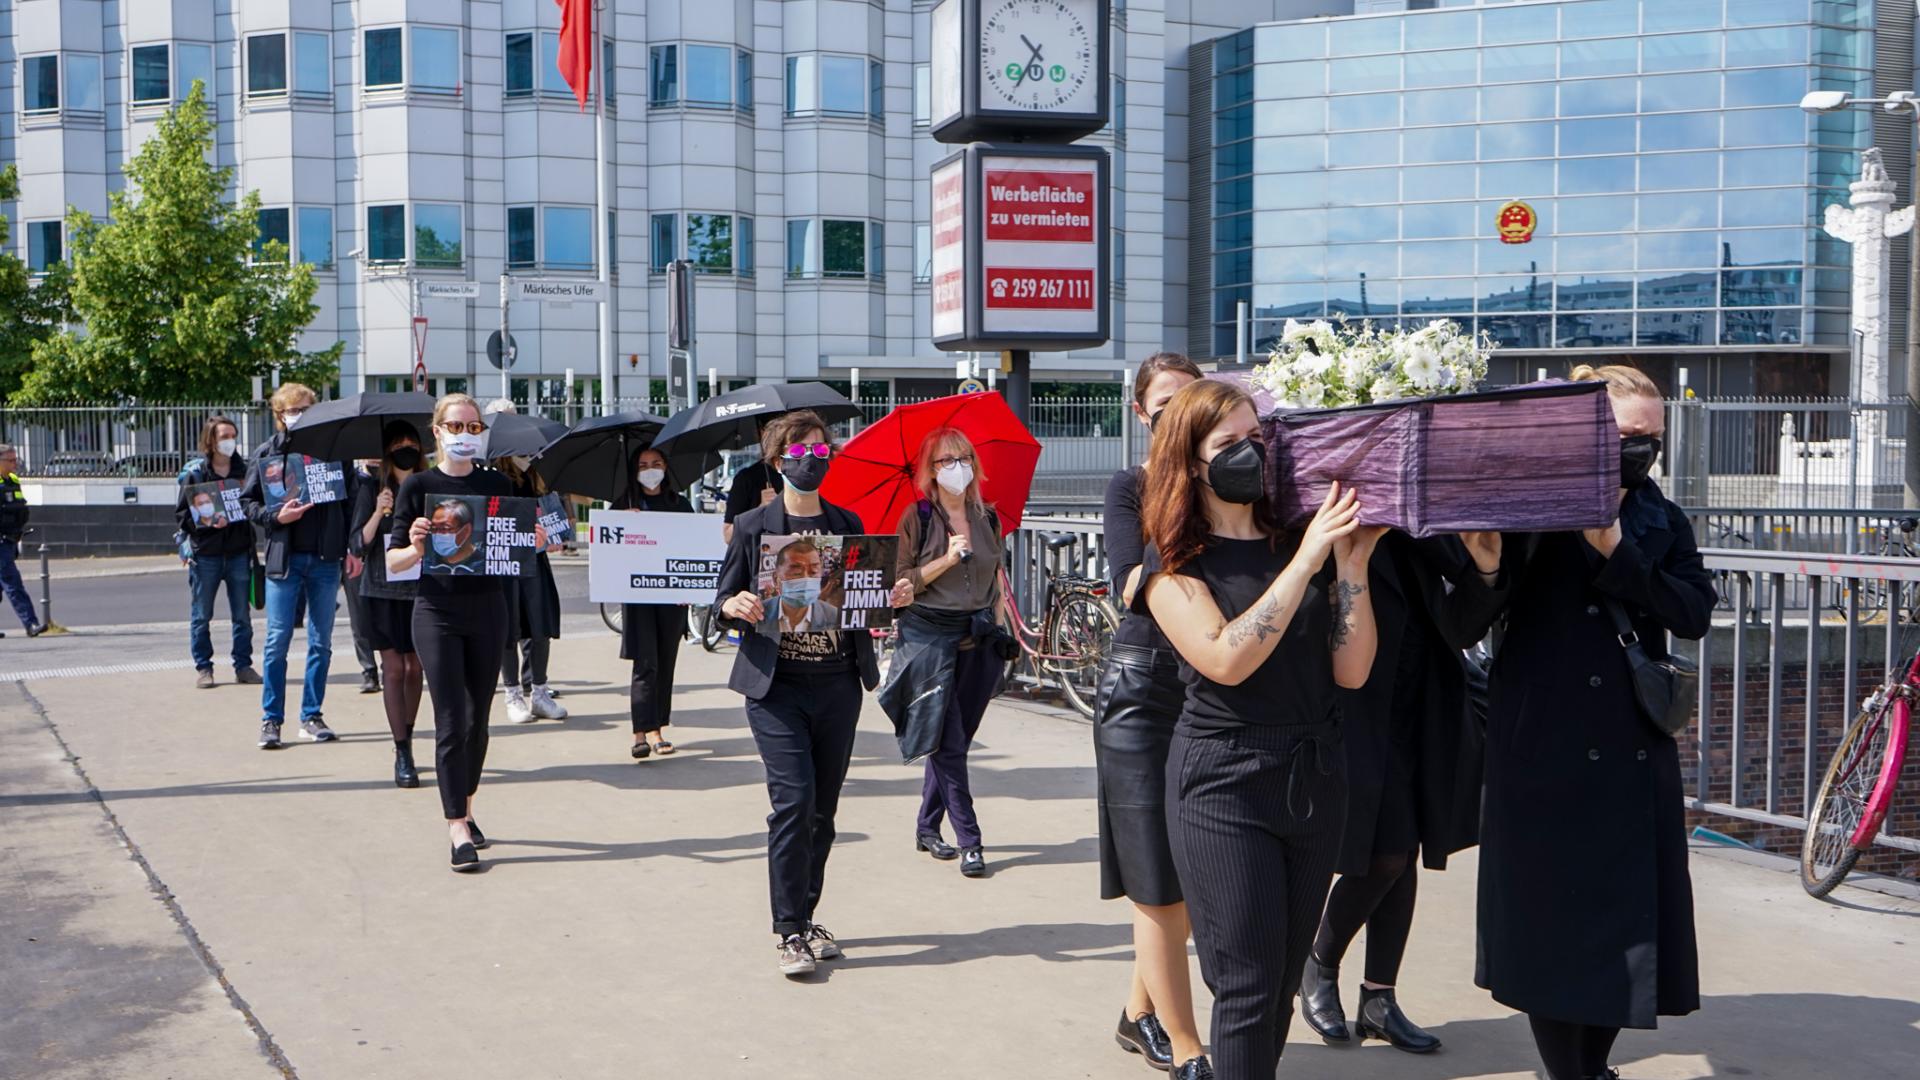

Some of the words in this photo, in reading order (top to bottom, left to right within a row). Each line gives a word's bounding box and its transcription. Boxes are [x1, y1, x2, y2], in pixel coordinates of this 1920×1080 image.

[1032, 5, 1040, 14] 12
[991, 185, 1085, 203] Werbefläche
[991, 213, 1009, 225] zu
[1013, 210, 1089, 227] vermieten
[523, 283, 572, 295] Märkisches
[574, 285, 594, 296] Ufer
[1013, 278, 1037, 298] 259
[1040, 279, 1064, 298] 267
[1068, 280, 1089, 298] 111
[305, 462, 327, 476] FREE
[306, 470, 344, 485] CHEUNG
[308, 481, 326, 495] KIM
[310, 491, 336, 504] HUNG
[487, 517, 517, 532] FREE
[540, 512, 560, 528] FREE
[486, 532, 536, 547] CHEUNG
[600, 526, 624, 544] RSF
[486, 546, 510, 561] KIM
[485, 561, 520, 576] HUNG
[668, 561, 706, 573] Keine
[709, 561, 722, 572] Fr
[632, 576, 666, 588] ohne
[669, 577, 718, 588] Pressef
[844, 570, 883, 590] FREE
[842, 589, 893, 609] JIMMY
[841, 609, 866, 629] LAI
